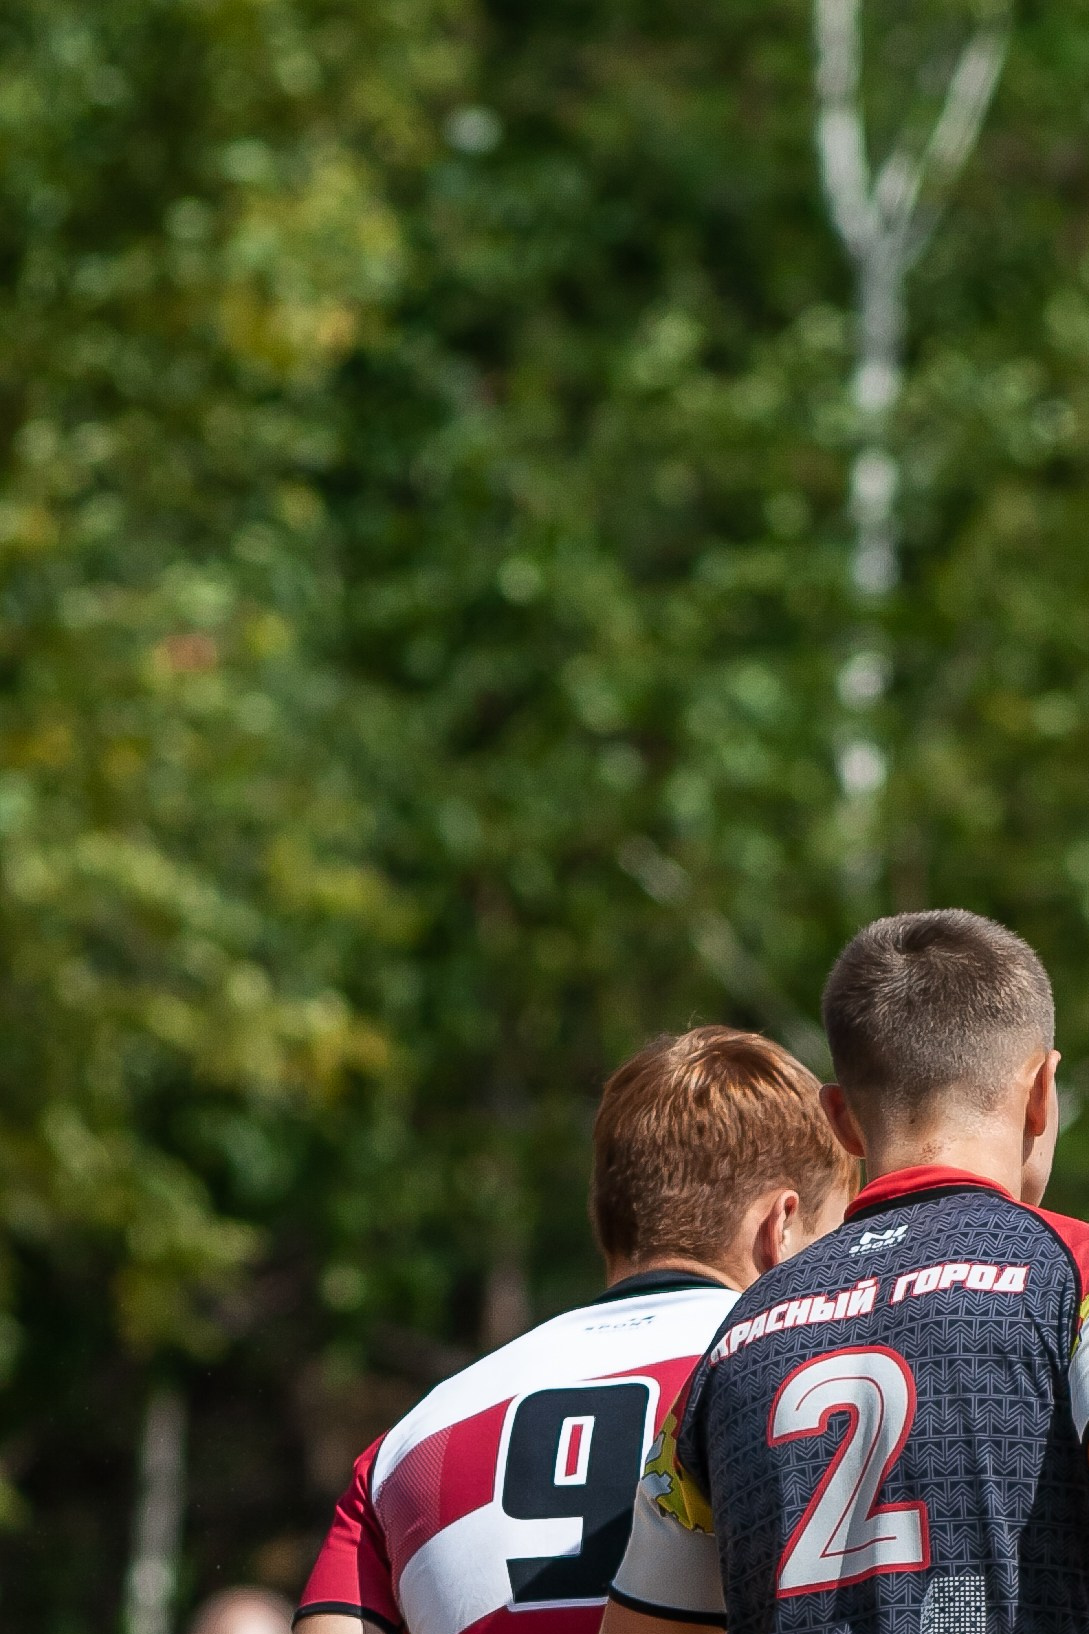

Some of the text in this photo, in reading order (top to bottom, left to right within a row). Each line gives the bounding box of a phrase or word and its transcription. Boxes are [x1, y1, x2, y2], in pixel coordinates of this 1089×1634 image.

[848, 1234, 907, 1254] SPORT
[891, 1262, 1031, 1305] ГОРОД
[501, 1382, 651, 1605] 9
[767, 1345, 932, 1599] 2
